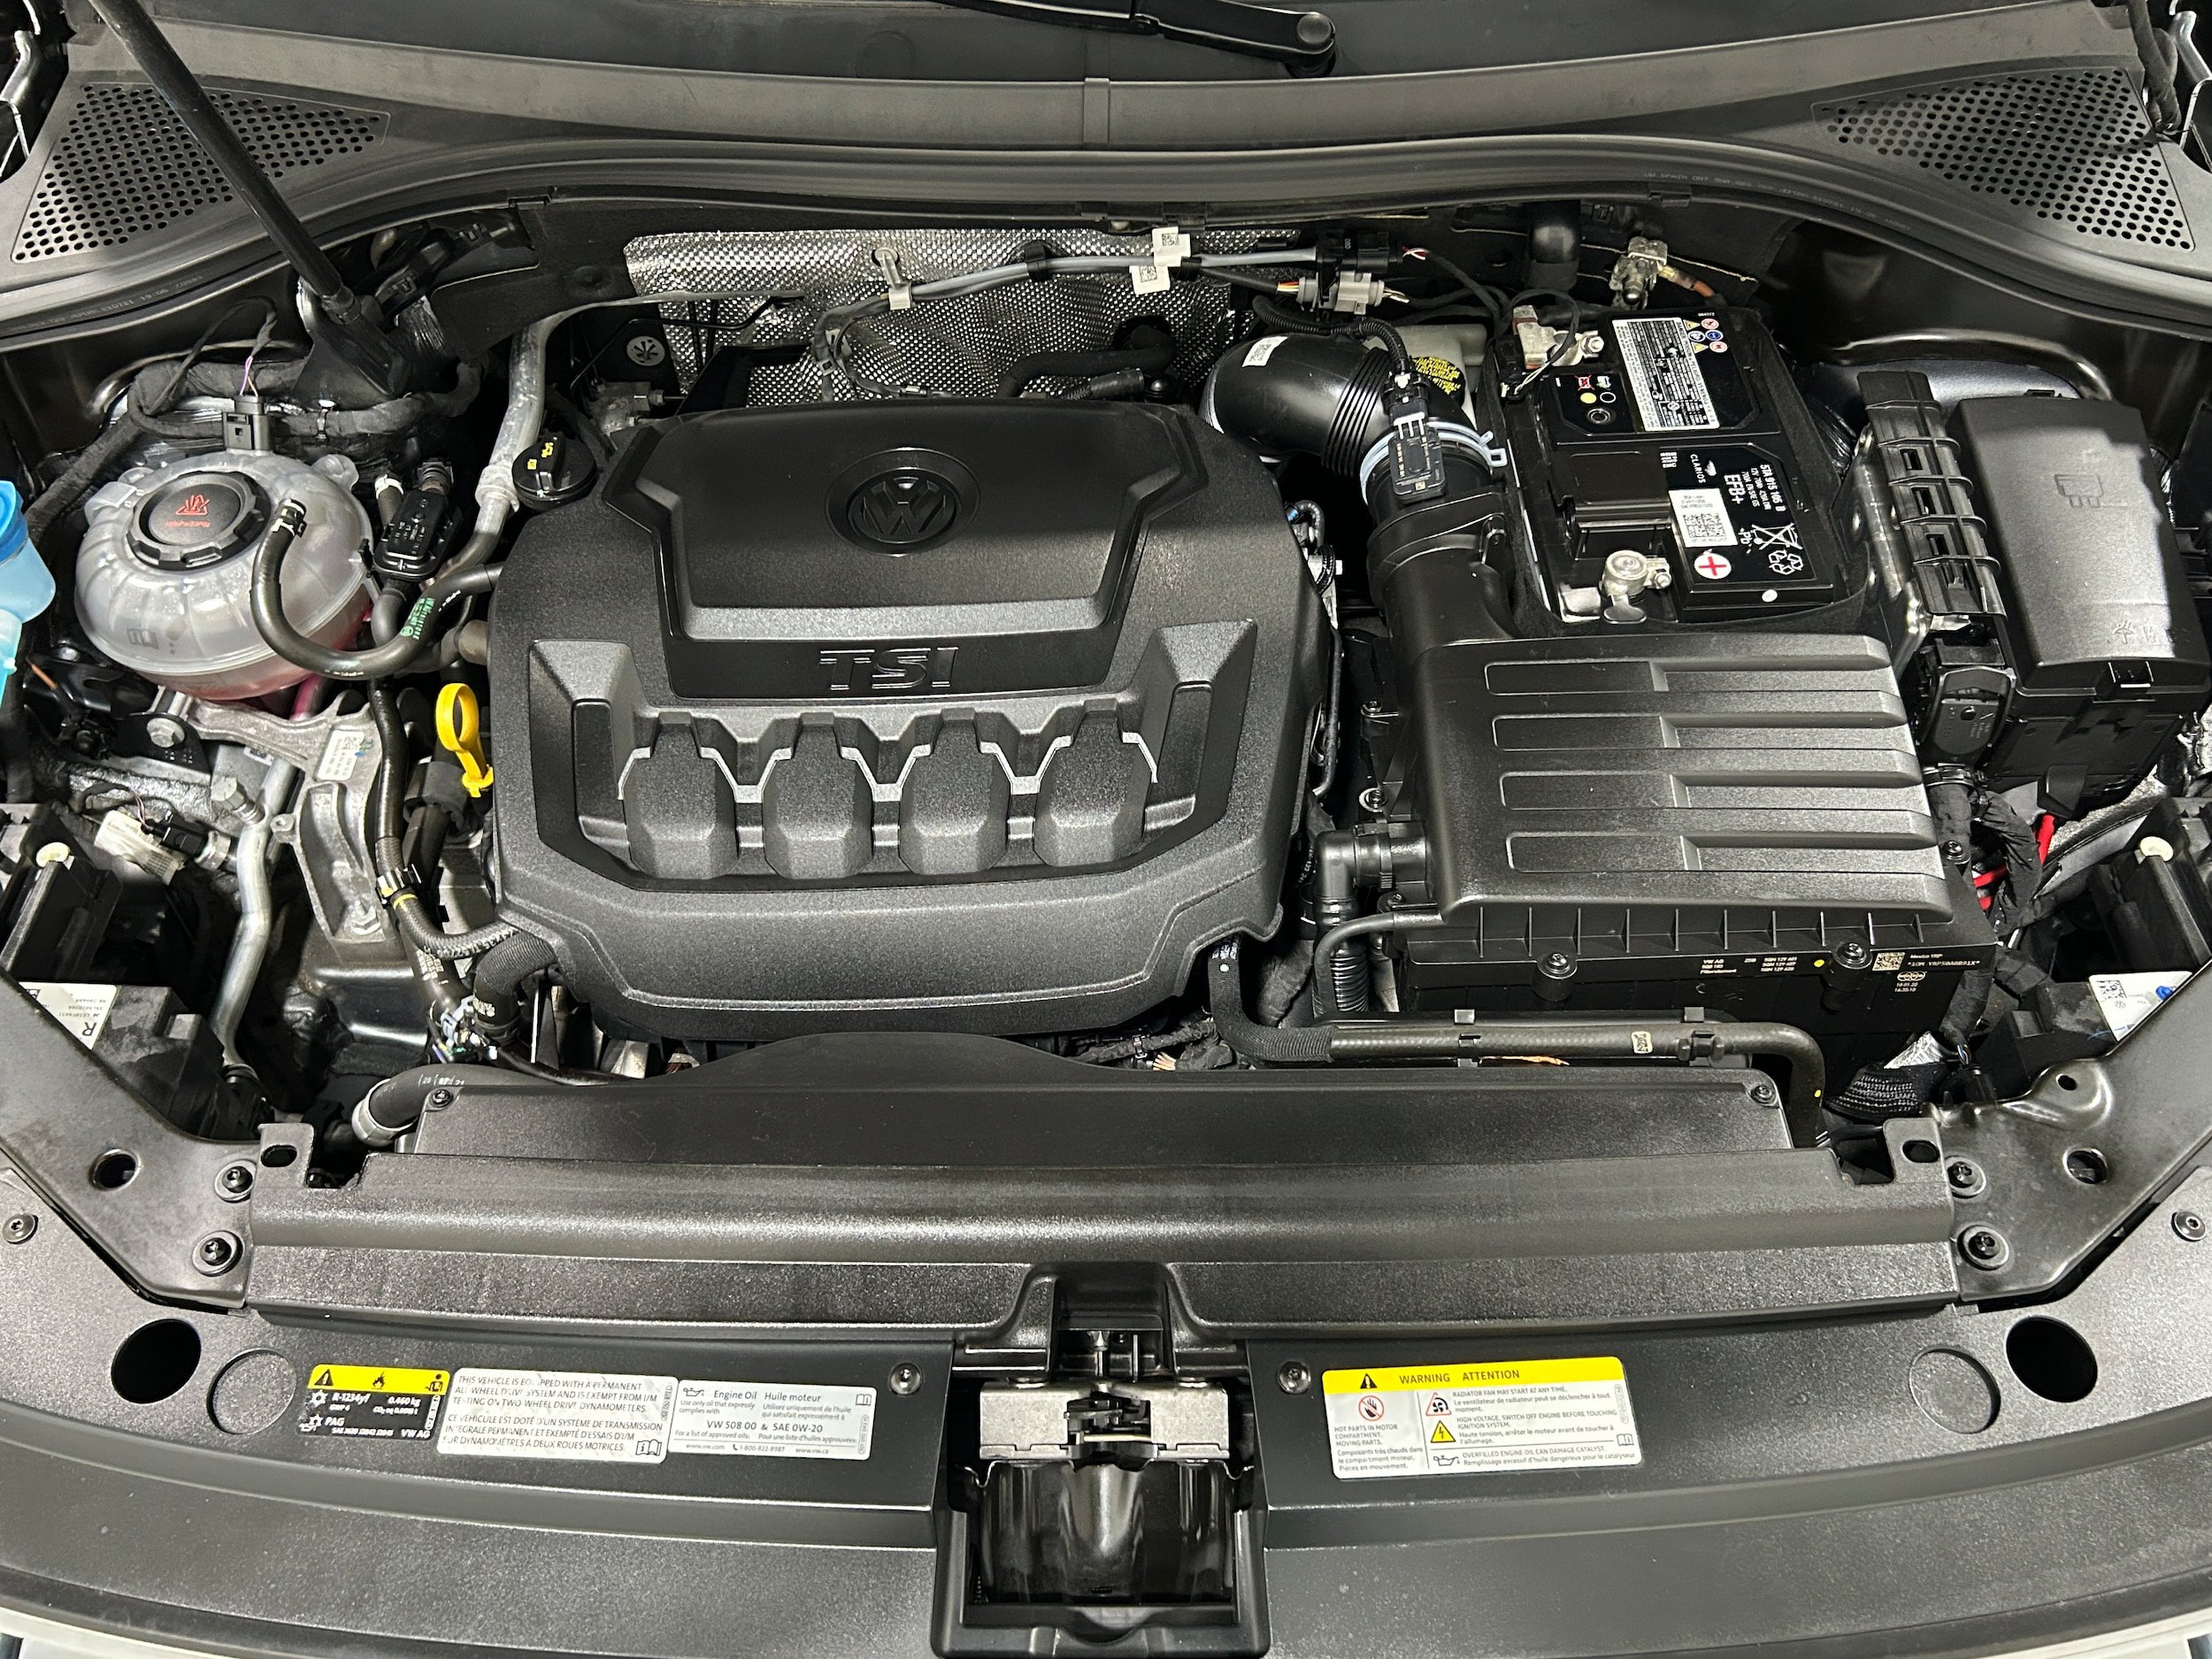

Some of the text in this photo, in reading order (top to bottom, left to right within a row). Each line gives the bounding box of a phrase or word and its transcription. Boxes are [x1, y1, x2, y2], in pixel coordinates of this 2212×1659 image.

[1690, 454, 1706, 484] CLARIOS
[1724, 473, 1747, 505] EFB+
[820, 647, 958, 691] TSI
[82, 1021, 96, 1036] R
[1399, 1370, 1519, 1384] WARNING ATTENTION
[592, 1381, 641, 1390] PERMANENT
[332, 1392, 372, 1405] R-1234yf
[713, 1390, 743, 1401] Engine
[764, 1392, 787, 1401] Huile
[788, 1393, 821, 1402] moteur
[325, 1417, 345, 1426] PAG
[513, 1415, 534, 1425] DOTÉ
[604, 1420, 663, 1430] TRANSMISSION
[791, 1424, 823, 1432] 0W-20
[557, 1440, 583, 1449] ROUES
